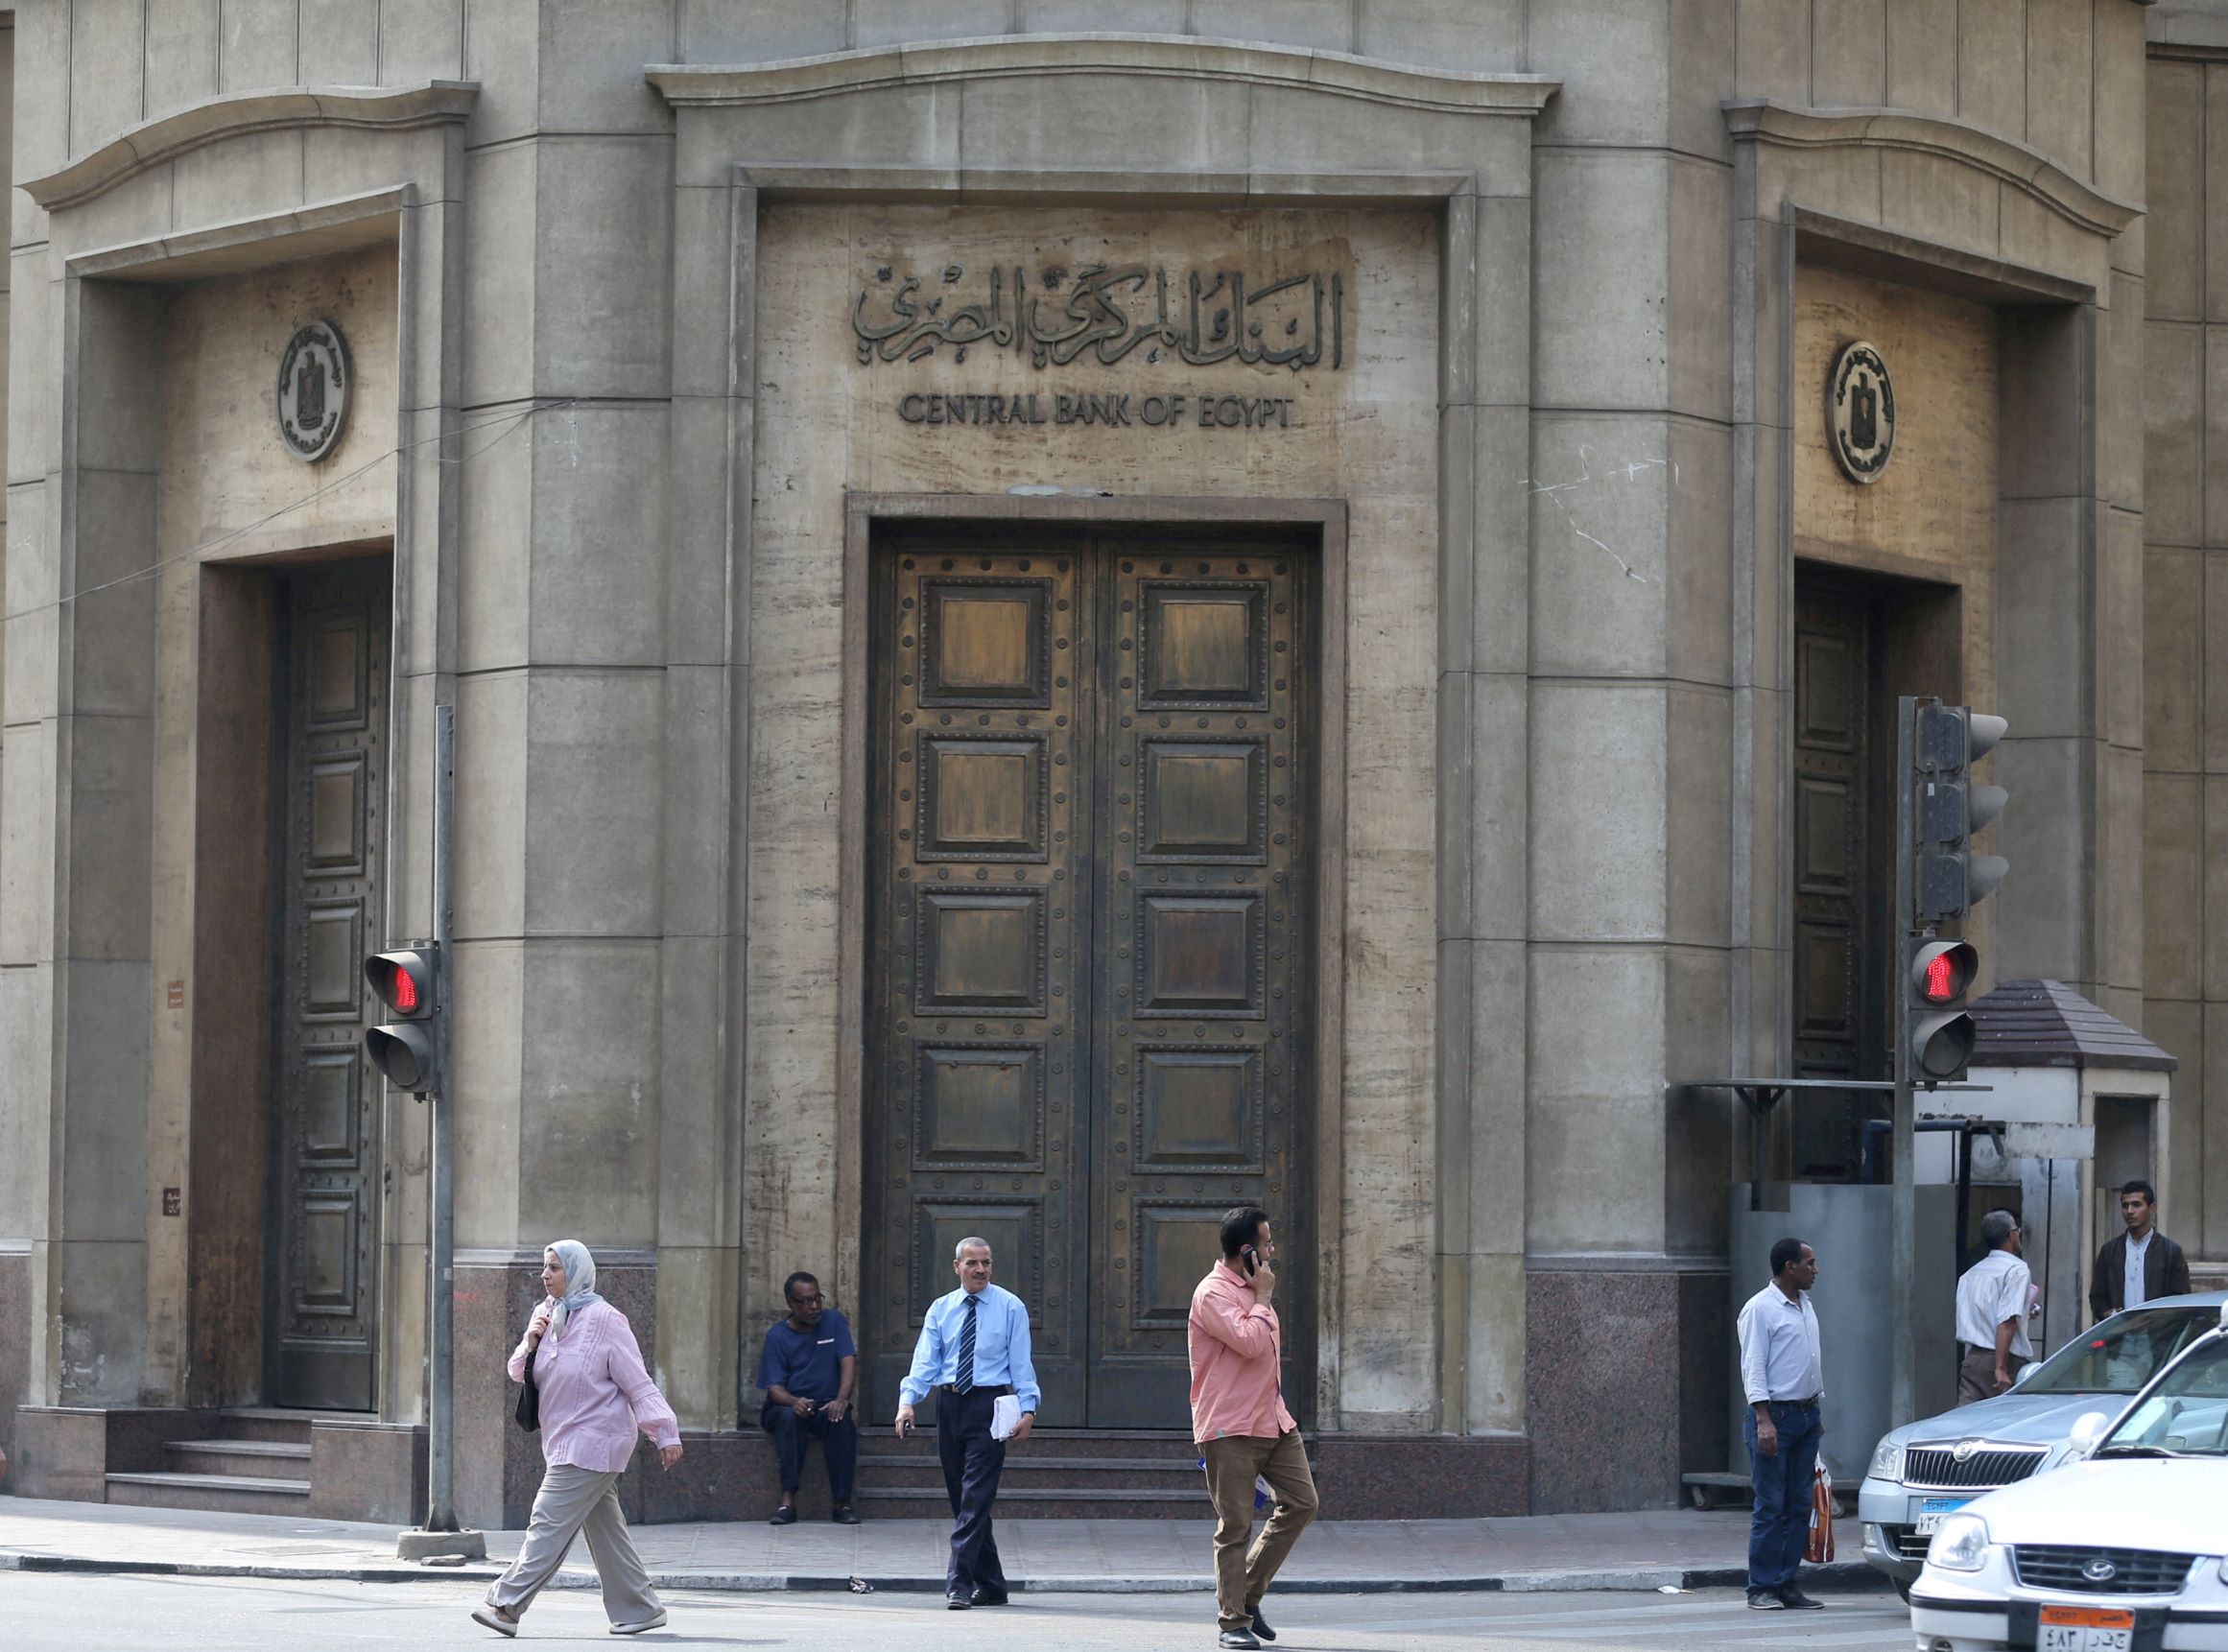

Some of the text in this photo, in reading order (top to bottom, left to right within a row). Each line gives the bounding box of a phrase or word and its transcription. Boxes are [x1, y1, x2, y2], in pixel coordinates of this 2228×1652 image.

[852, 262, 1342, 370] البنك المركزي المصري
[897, 393, 1294, 428] CENTRAL BANK OF EGYPT
[1927, 1501, 1949, 1510] EGYPT
